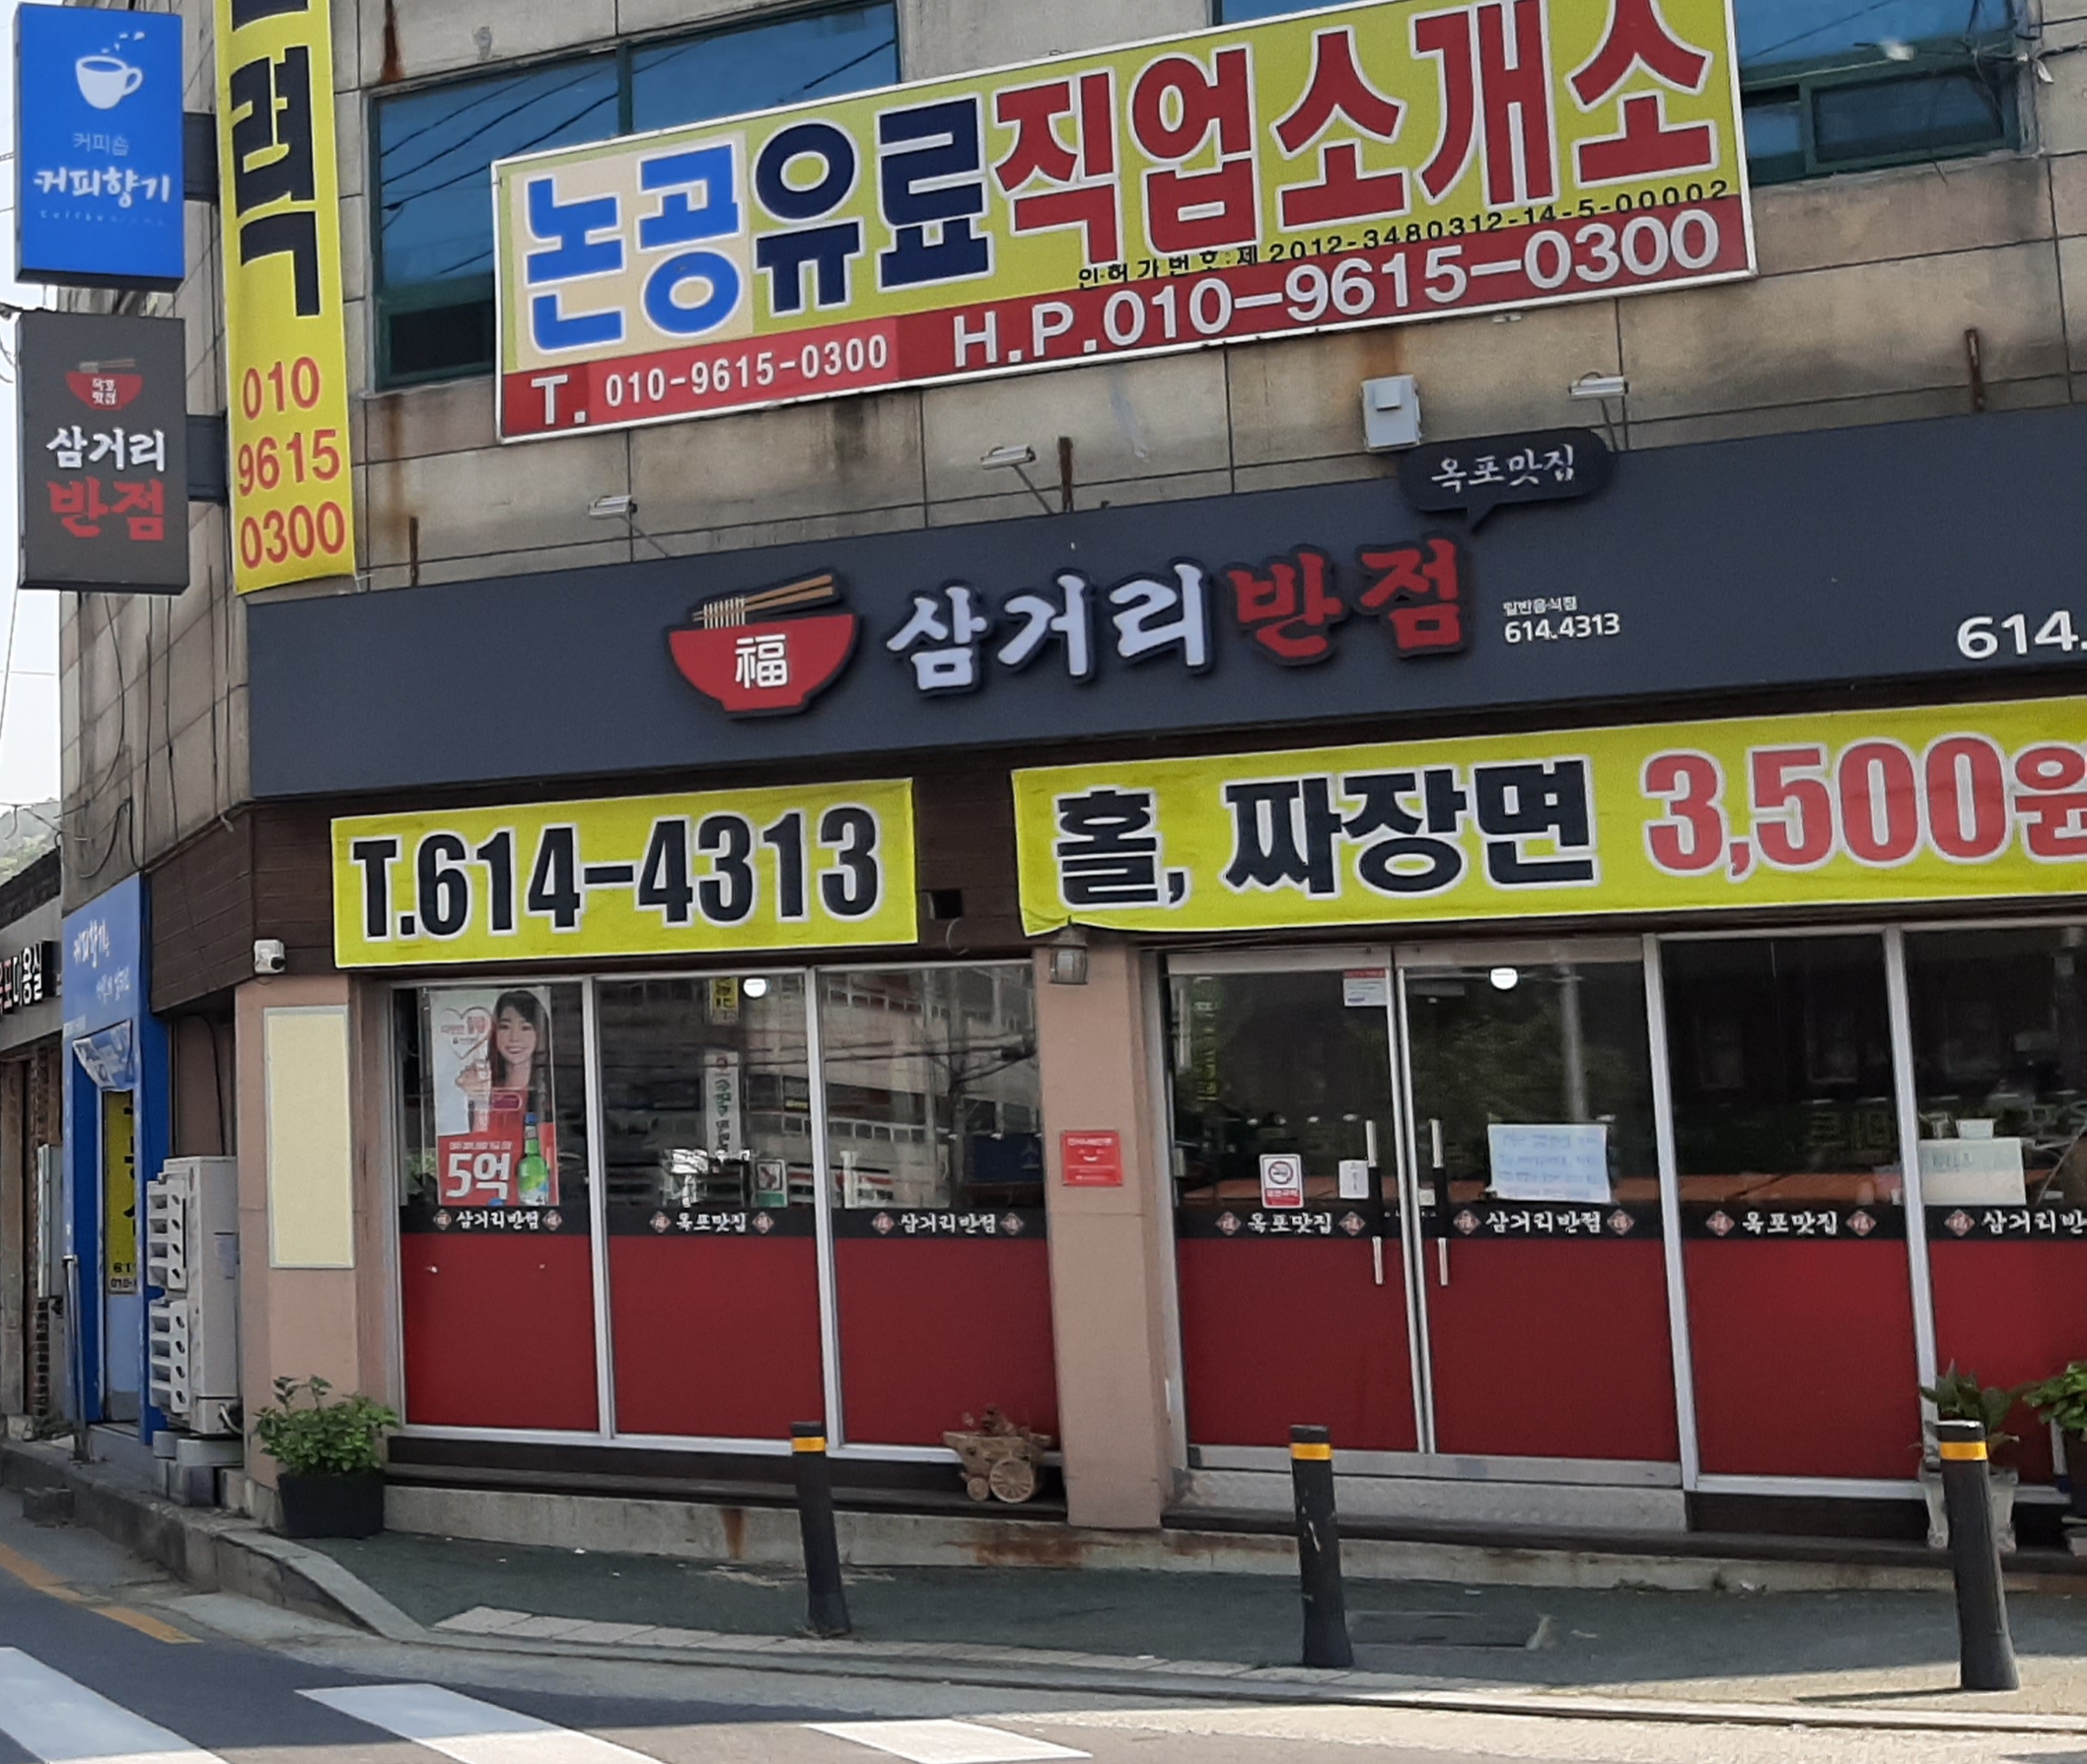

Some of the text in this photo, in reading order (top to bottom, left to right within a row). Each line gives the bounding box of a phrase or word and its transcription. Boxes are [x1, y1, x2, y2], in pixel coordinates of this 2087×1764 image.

[73, 133, 129, 156] 커피숍
[229, 0, 321, 317] 력
[34, 166, 171, 208] 커피향기
[1269, 179, 1727, 263] 2012-3480312-14-5-00002
[242, 356, 322, 420] 010
[531, 374, 587, 425] T.
[605, 334, 888, 407] 010-9615-0300
[45, 425, 165, 472] 삼거리
[238, 428, 341, 496] 9615
[1431, 444, 1574, 493] 옥포맛집
[45, 476, 165, 540] 반점
[240, 501, 346, 569] 0300
[1504, 612, 1620, 643] 614.4313
[734, 633, 788, 689] 福
[1224, 758, 1596, 895] 짜장면
[1643, 736, 2087, 877] 3,500원
[351, 805, 881, 939] T.614-4313
[0, 941, 42, 1015] 포미용실
[445, 1152, 512, 1201] 5억
[1484, 1210, 1602, 1235] 삼거리반점
[1742, 1210, 1838, 1235] 옥포맛집
